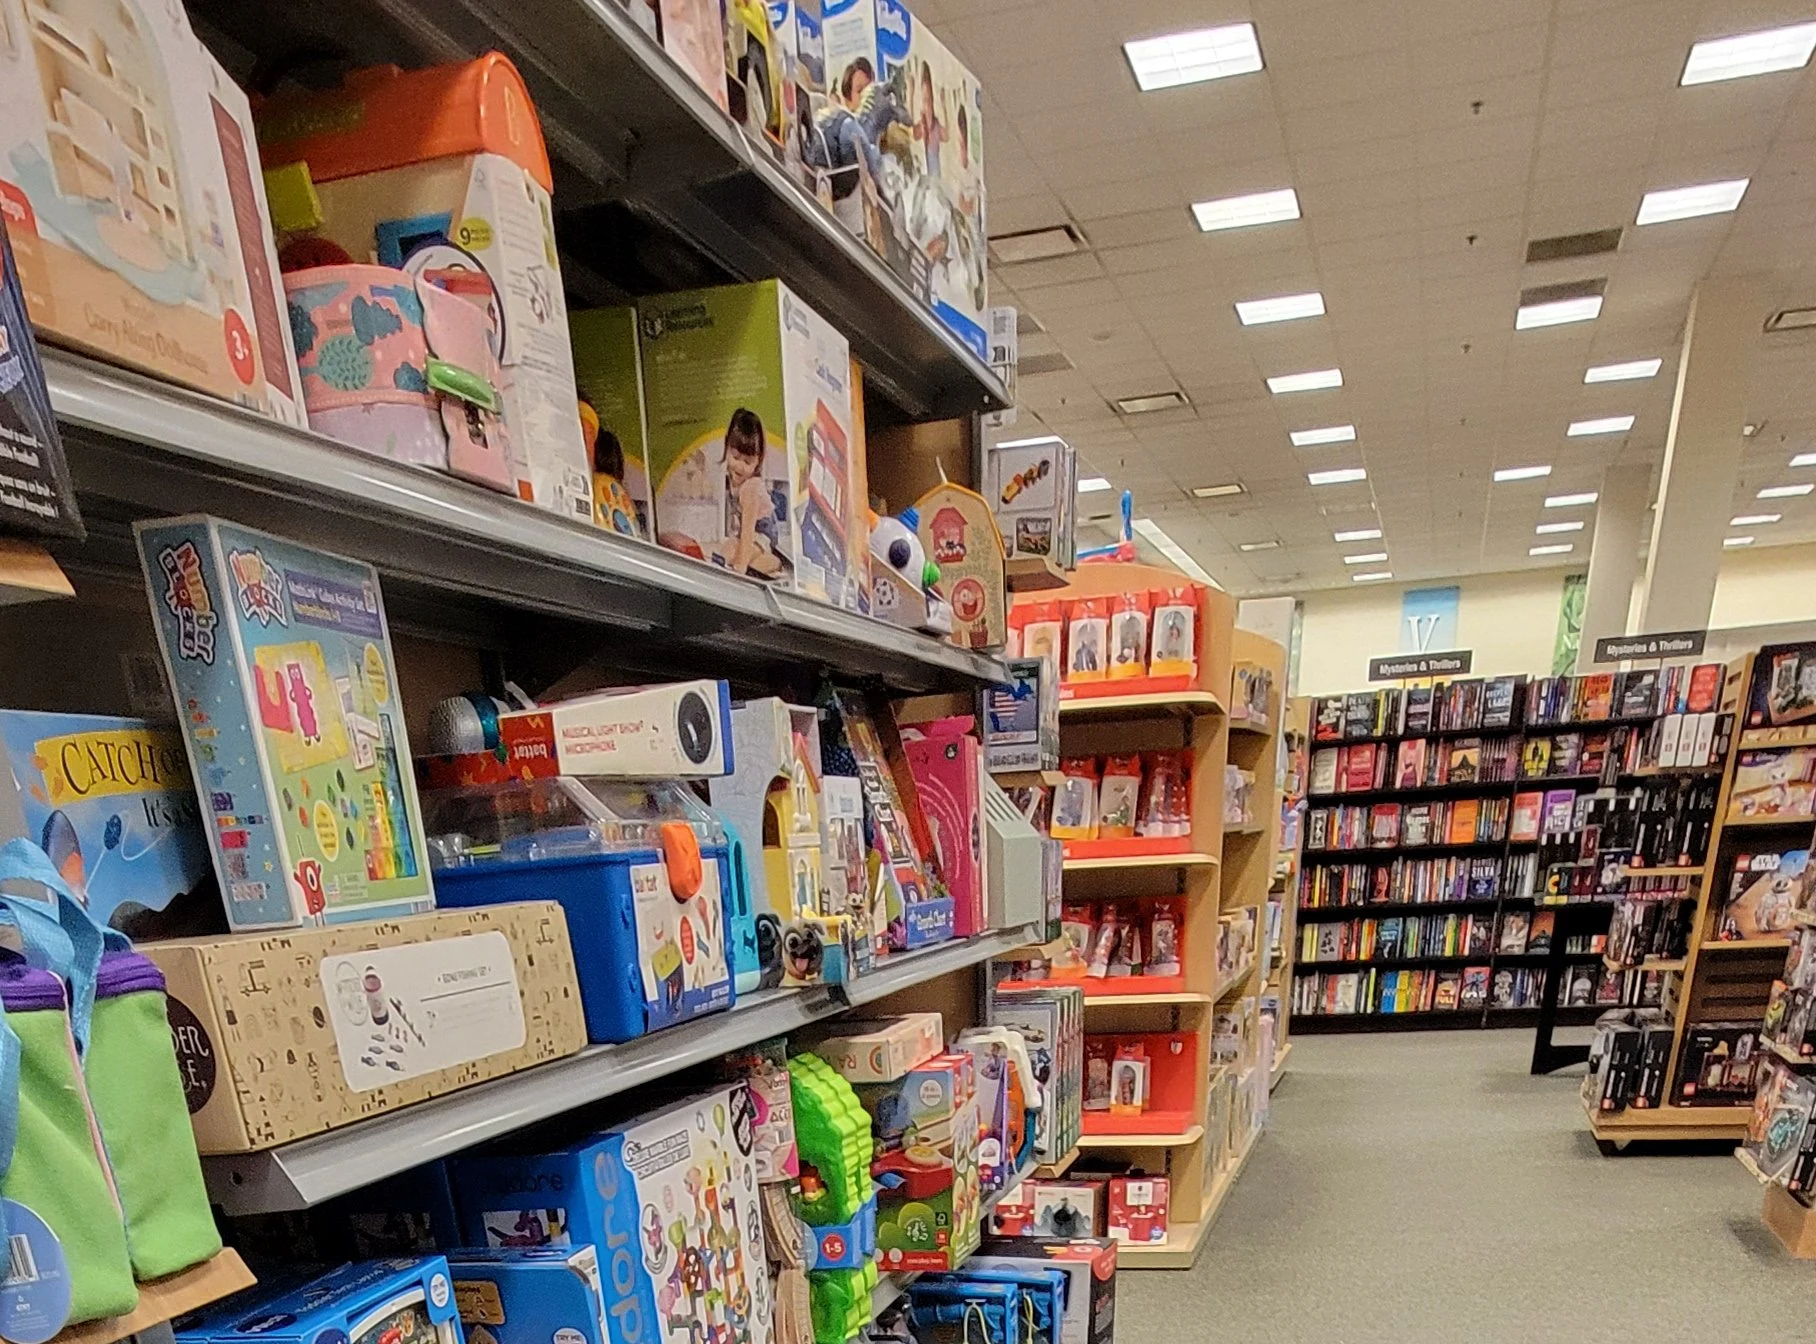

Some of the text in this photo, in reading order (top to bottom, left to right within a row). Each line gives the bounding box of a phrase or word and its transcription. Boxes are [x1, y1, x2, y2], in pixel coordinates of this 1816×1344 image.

[1607, 639, 1694, 656] Mysteries & Thrillers
[1379, 658, 1462, 676] Mysteries & Thrillers
[61, 739, 160, 795] CATCH
[824, 1242, 843, 1255] 1-5
